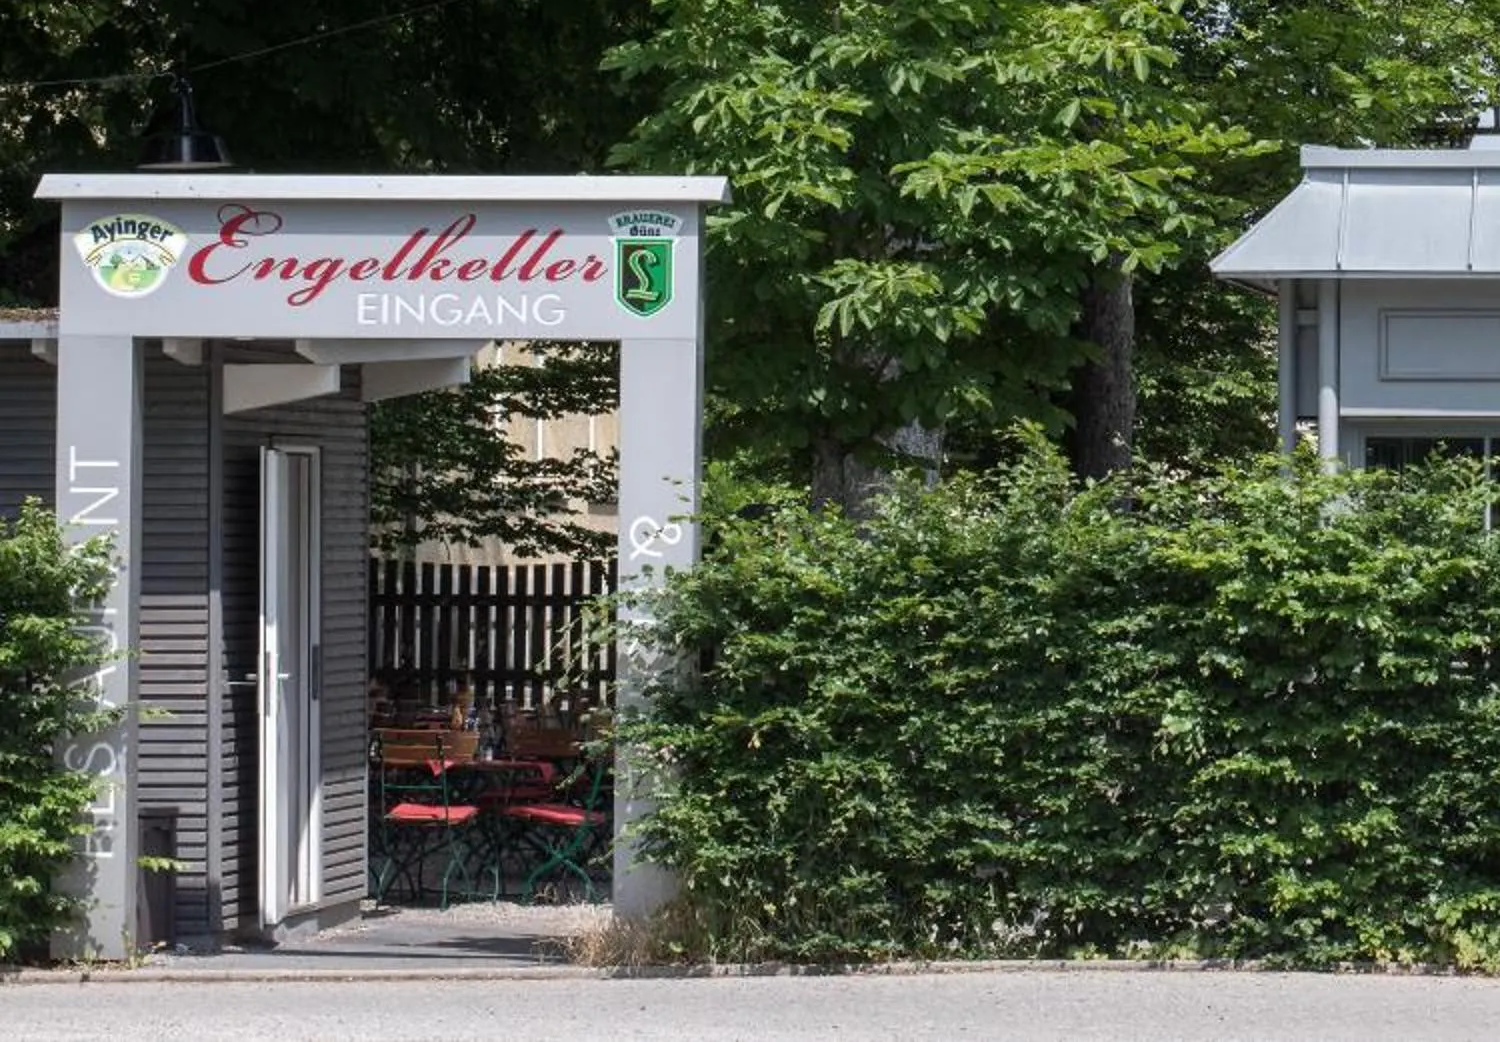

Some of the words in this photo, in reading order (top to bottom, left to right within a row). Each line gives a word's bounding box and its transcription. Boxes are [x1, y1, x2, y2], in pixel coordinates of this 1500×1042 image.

[91, 217, 174, 244] Ayinger
[616, 213, 676, 229] BRAUEREI
[188, 203, 608, 307] Engelkeller
[356, 293, 566, 326] EINGANG
[629, 515, 683, 560] &
